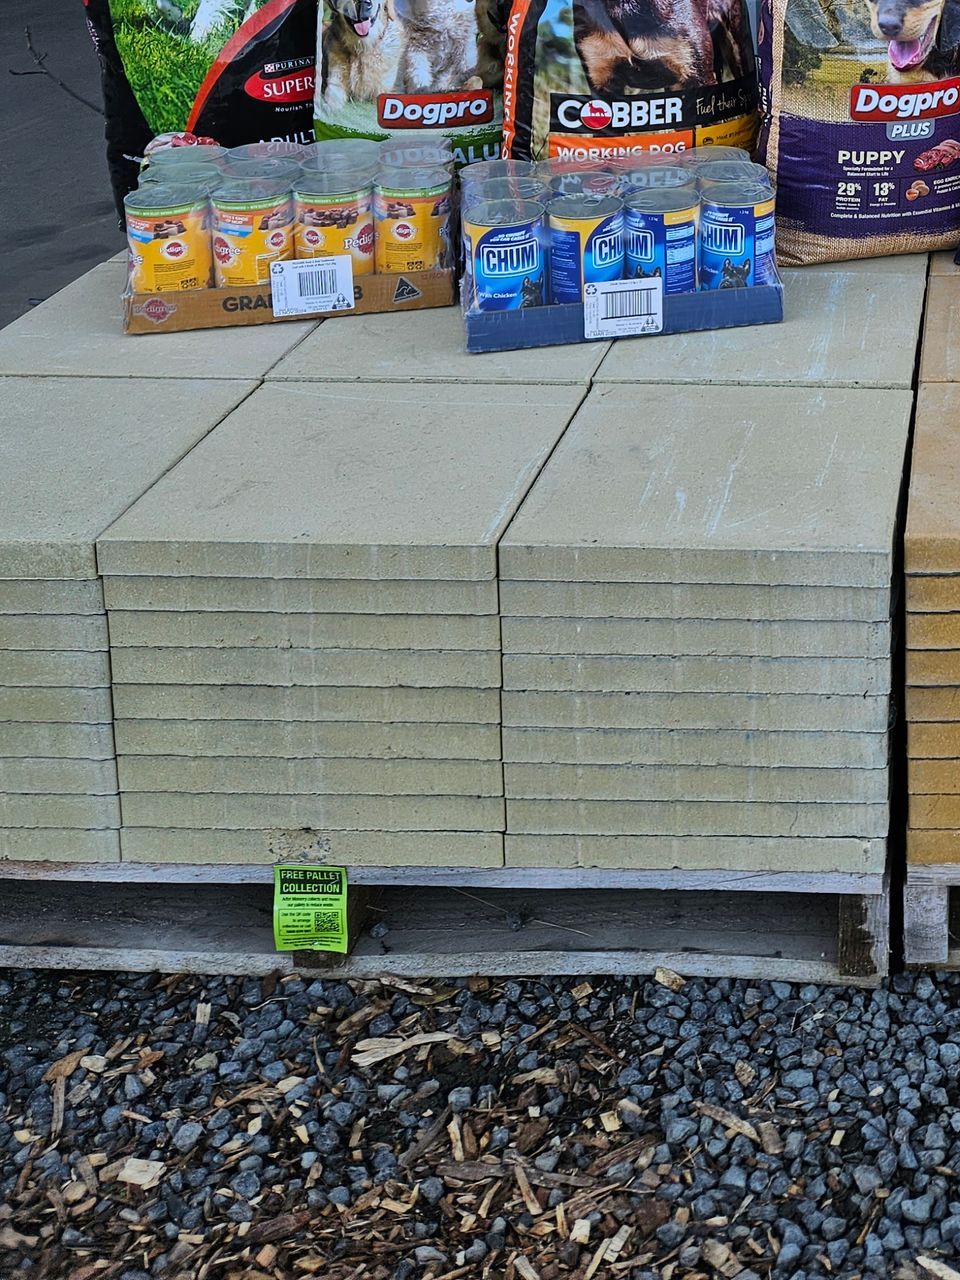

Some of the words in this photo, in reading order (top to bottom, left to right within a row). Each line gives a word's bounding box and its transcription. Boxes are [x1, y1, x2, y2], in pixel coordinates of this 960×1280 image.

[275, 58, 312, 71] PURINA
[503, 12, 521, 122] WORKING
[263, 76, 315, 98] SUPER
[383, 98, 488, 125] Dogpro
[557, 96, 683, 129] COBBER
[696, 95, 716, 115] Fuel
[717, 92, 737, 111] their
[855, 86, 959, 118] Dogpro
[890, 121, 931, 138] PLUS
[454, 142, 500, 165] ALU
[501, 130, 512, 160] FO
[556, 144, 643, 162] WORKING
[649, 141, 686, 155] DOG
[838, 150, 906, 165] PUPPY
[838, 182, 862, 196] 29%
[343, 234, 376, 251] Pedig
[598, 232, 623, 262] CHU
[629, 231, 648, 258] UM
[486, 242, 535, 273] CHUM
[281, 870, 305, 879] FREE
[306, 871, 340, 880] PALLET
[282, 883, 340, 893] COLLECTION
